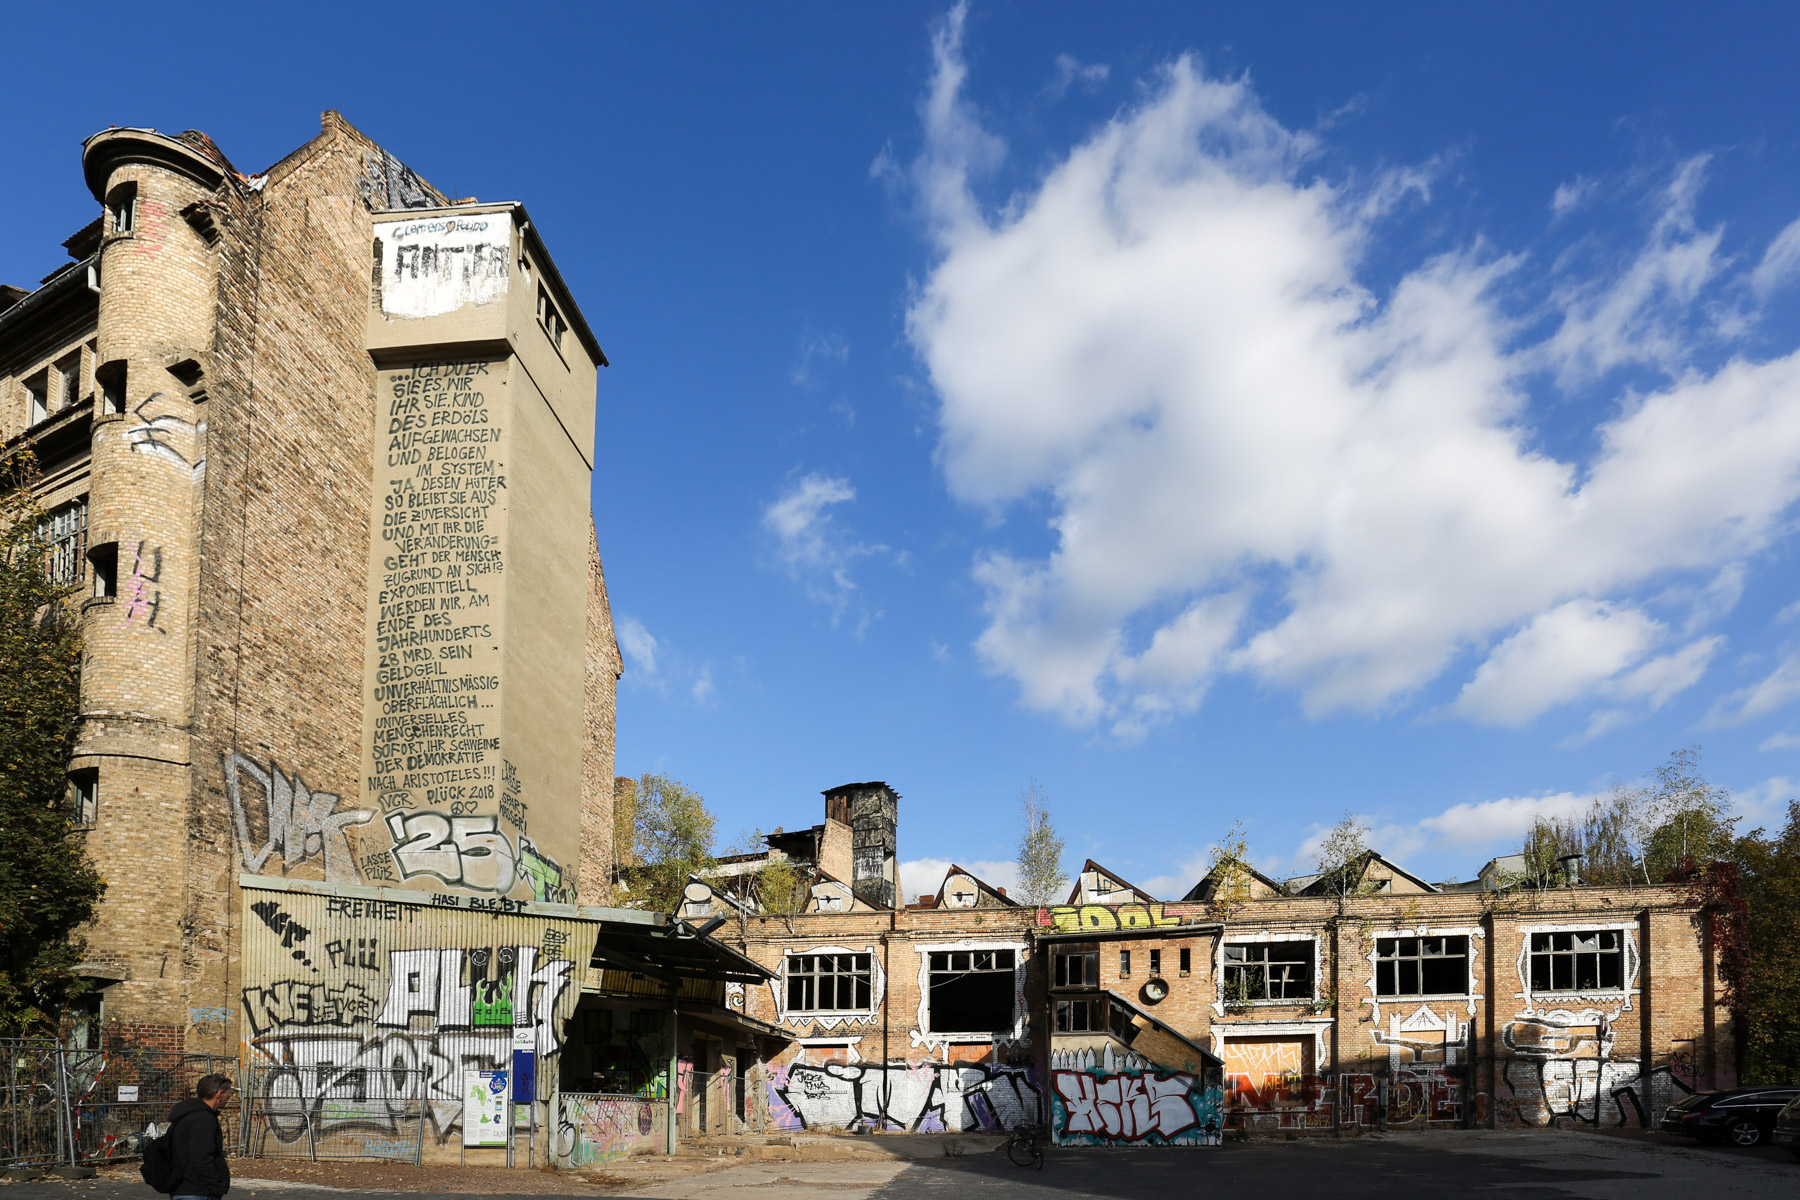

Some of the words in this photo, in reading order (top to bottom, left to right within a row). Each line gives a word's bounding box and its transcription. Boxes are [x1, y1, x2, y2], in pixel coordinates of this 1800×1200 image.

[444, 362, 464, 377] DU
[465, 361, 489, 376] ER
[393, 380, 421, 398] SIE
[447, 377, 474, 391] WIR
[390, 397, 420, 416] IHR
[452, 392, 484, 408] KIND
[388, 414, 427, 434] DES
[388, 428, 502, 451] AUFGEWACHSEN
[388, 448, 422, 467] UND
[427, 446, 487, 462] BELOGEN
[416, 463, 432, 478] IM
[441, 459, 494, 476] SYSTEM
[390, 478, 415, 494] JA
[421, 477, 461, 491] DESEN
[465, 476, 507, 490] HÜTER
[385, 495, 404, 511] SO
[408, 492, 448, 508] BLEIBT
[449, 491, 467, 504] SIE
[470, 490, 497, 505] AUS
[383, 511, 407, 527] DIE
[411, 505, 490, 522] ZUVERSICHT
[382, 525, 414, 541] UND
[419, 522, 439, 536] MIT
[443, 521, 462, 534] IHR
[464, 520, 484, 534] DIE
[384, 552, 427, 571] GEHT
[432, 550, 451, 563] DER
[455, 550, 501, 562] MENSCH
[383, 567, 442, 588] ZUGRUND
[446, 564, 462, 578] AN
[378, 579, 478, 604] EXPONENTIELL
[380, 598, 435, 620] WERDEN
[469, 594, 490, 607] AM
[376, 616, 416, 636] ENDE
[423, 611, 452, 627] DES
[376, 624, 492, 653] JAHRHUNDERTS
[379, 652, 399, 668] 28
[402, 647, 435, 663] MRD.
[439, 644, 472, 659] SEIN
[376, 661, 447, 684] GELDGEIL
[375, 711, 467, 728] UNIVERSELLES
[373, 724, 485, 744] MENSCHENRECHT
[427, 739, 446, 752] IHR
[450, 737, 500, 752] SCHWEINE
[375, 758, 404, 774] DER
[406, 751, 484, 771] DEMOKRATIE
[368, 775, 396, 791] NACH
[426, 785, 466, 805] PLÜCK
[469, 784, 494, 799] 2018
[501, 792, 528, 819] SPART
[360, 851, 391, 869] LASSE
[326, 900, 421, 922] FREIHEIT
[432, 894, 459, 907] HASI
